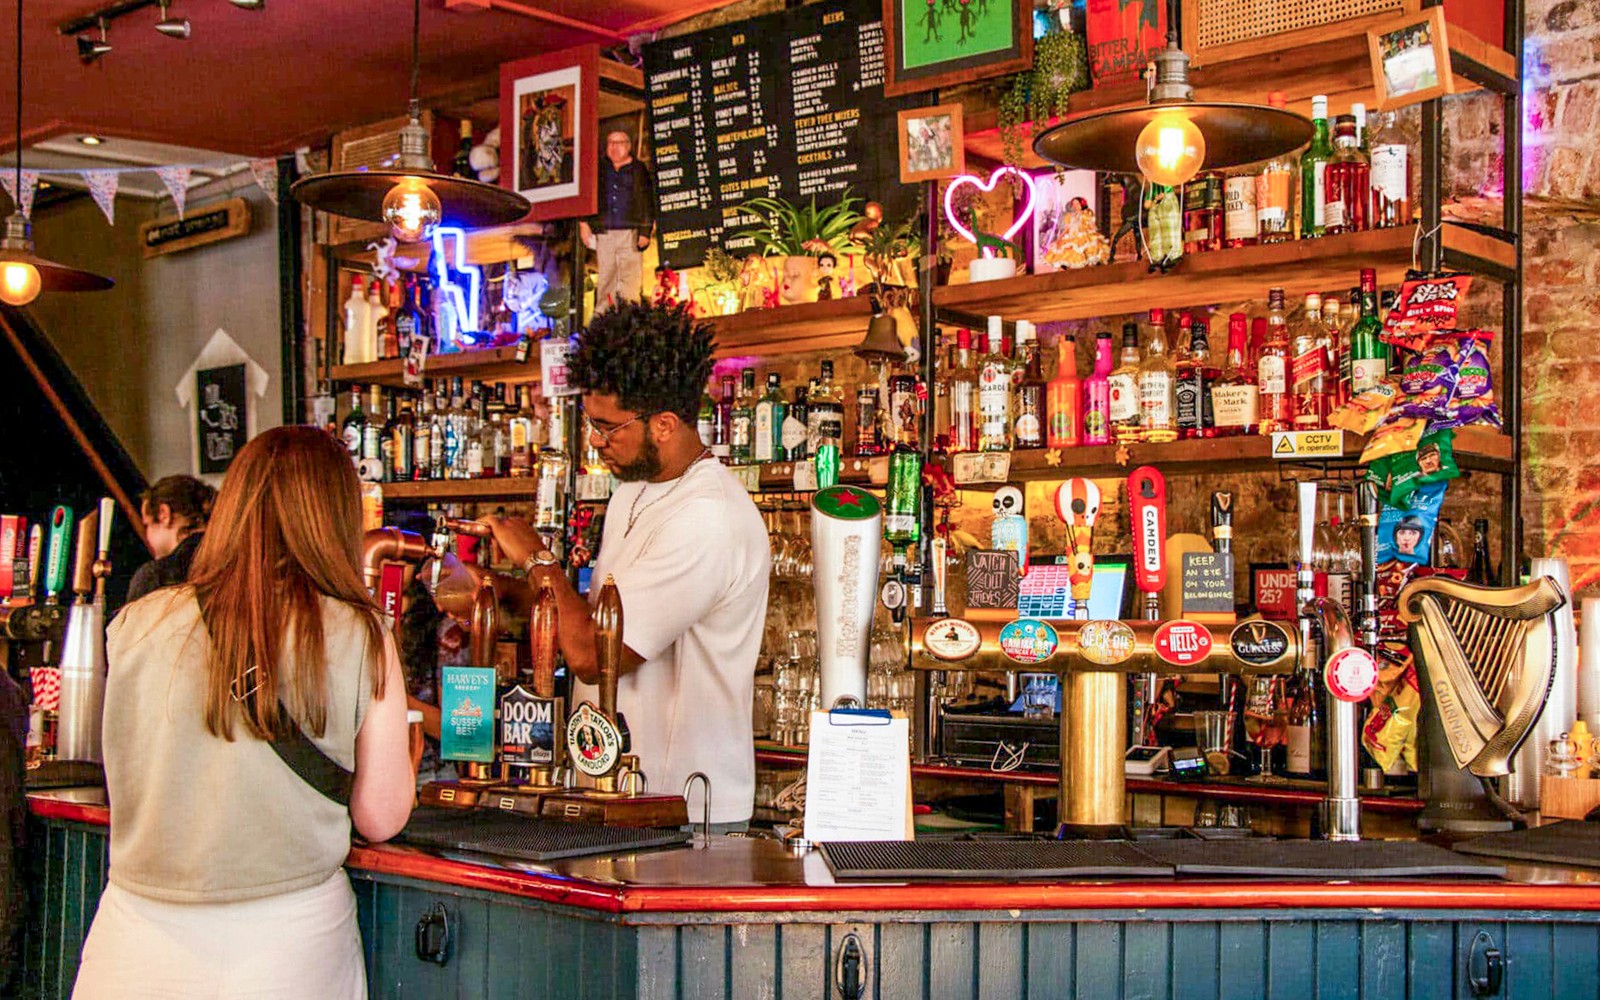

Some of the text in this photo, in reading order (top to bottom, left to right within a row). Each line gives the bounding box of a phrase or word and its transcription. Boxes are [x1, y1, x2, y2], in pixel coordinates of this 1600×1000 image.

[823, 11, 845, 25] BEERS
[790, 34, 822, 48] HEINEKEN
[1089, 37, 1128, 59] BITTER
[791, 44, 815, 55] AMSTEL
[860, 47, 873, 56] OLD
[711, 55, 737, 70] MERLOT
[712, 68, 730, 78] CHILE
[792, 62, 839, 78] CAMDEN HELLS
[792, 71, 836, 86] CAMDEN PALE
[713, 81, 739, 95] MALBEC
[714, 89, 747, 103] ARGENTINA
[653, 105, 675, 116] FRANCE
[794, 100, 811, 109] NECK
[816, 103, 830, 112] RAY
[715, 107, 733, 120] PINOT
[795, 108, 860, 129] FEVER TREE MIXERS
[716, 118, 734, 128] CHILE
[796, 119, 859, 137] REGULAR AND LIGHT
[796, 130, 843, 144] ELDER FLOWER
[718, 143, 736, 152] ITALY
[797, 137, 848, 152] MEDITERRANEAN
[657, 153, 679, 164] FRANCE
[797, 150, 832, 165] COCKTAILS
[799, 163, 857, 180] ESPRESSO MARTINI
[659, 178, 681, 188] FRANCE
[660, 190, 691, 204] SAUVIGNON
[721, 191, 744, 201] FRANCE
[800, 186, 817, 196] DARK
[673, 199, 699, 211] ZEALAND
[723, 216, 741, 228] PINOT
[725, 236, 756, 250] PROVENCE
[1214, 388, 1249, 399] Maker's
[1223, 398, 1247, 406] Mark
[1306, 435, 1332, 444] CCTV
[1306, 444, 1339, 452] operation
[1146, 510, 1157, 566] CAMDEN
[973, 552, 1008, 572] WATCH
[1188, 555, 1215, 567] KEEP
[1203, 568, 1222, 577] EYE
[984, 571, 1005, 590] OUT
[1203, 580, 1226, 588] YOUR
[836, 535, 862, 659] Heineken
[1184, 591, 1233, 599] BELONGINGS
[1259, 590, 1283, 604] 25?
[929, 621, 975, 638] BIRRA MORETTI
[1002, 637, 1034, 649] GAMMA
[1081, 631, 1129, 650] NECK OIL
[1169, 633, 1199, 653] HELLS
[1237, 643, 1282, 654] GUINNESS
[447, 673, 489, 685] HARVEY'S
[503, 701, 552, 723] DOOM
[1435, 679, 1472, 755] GUINNESS
[450, 716, 483, 728] SUSSEX
[455, 726, 477, 736] BEST
[503, 722, 533, 745] BAR
[569, 713, 615, 748] TIMOTHY TAYLOR'S
[577, 752, 611, 771] LANDLORD
